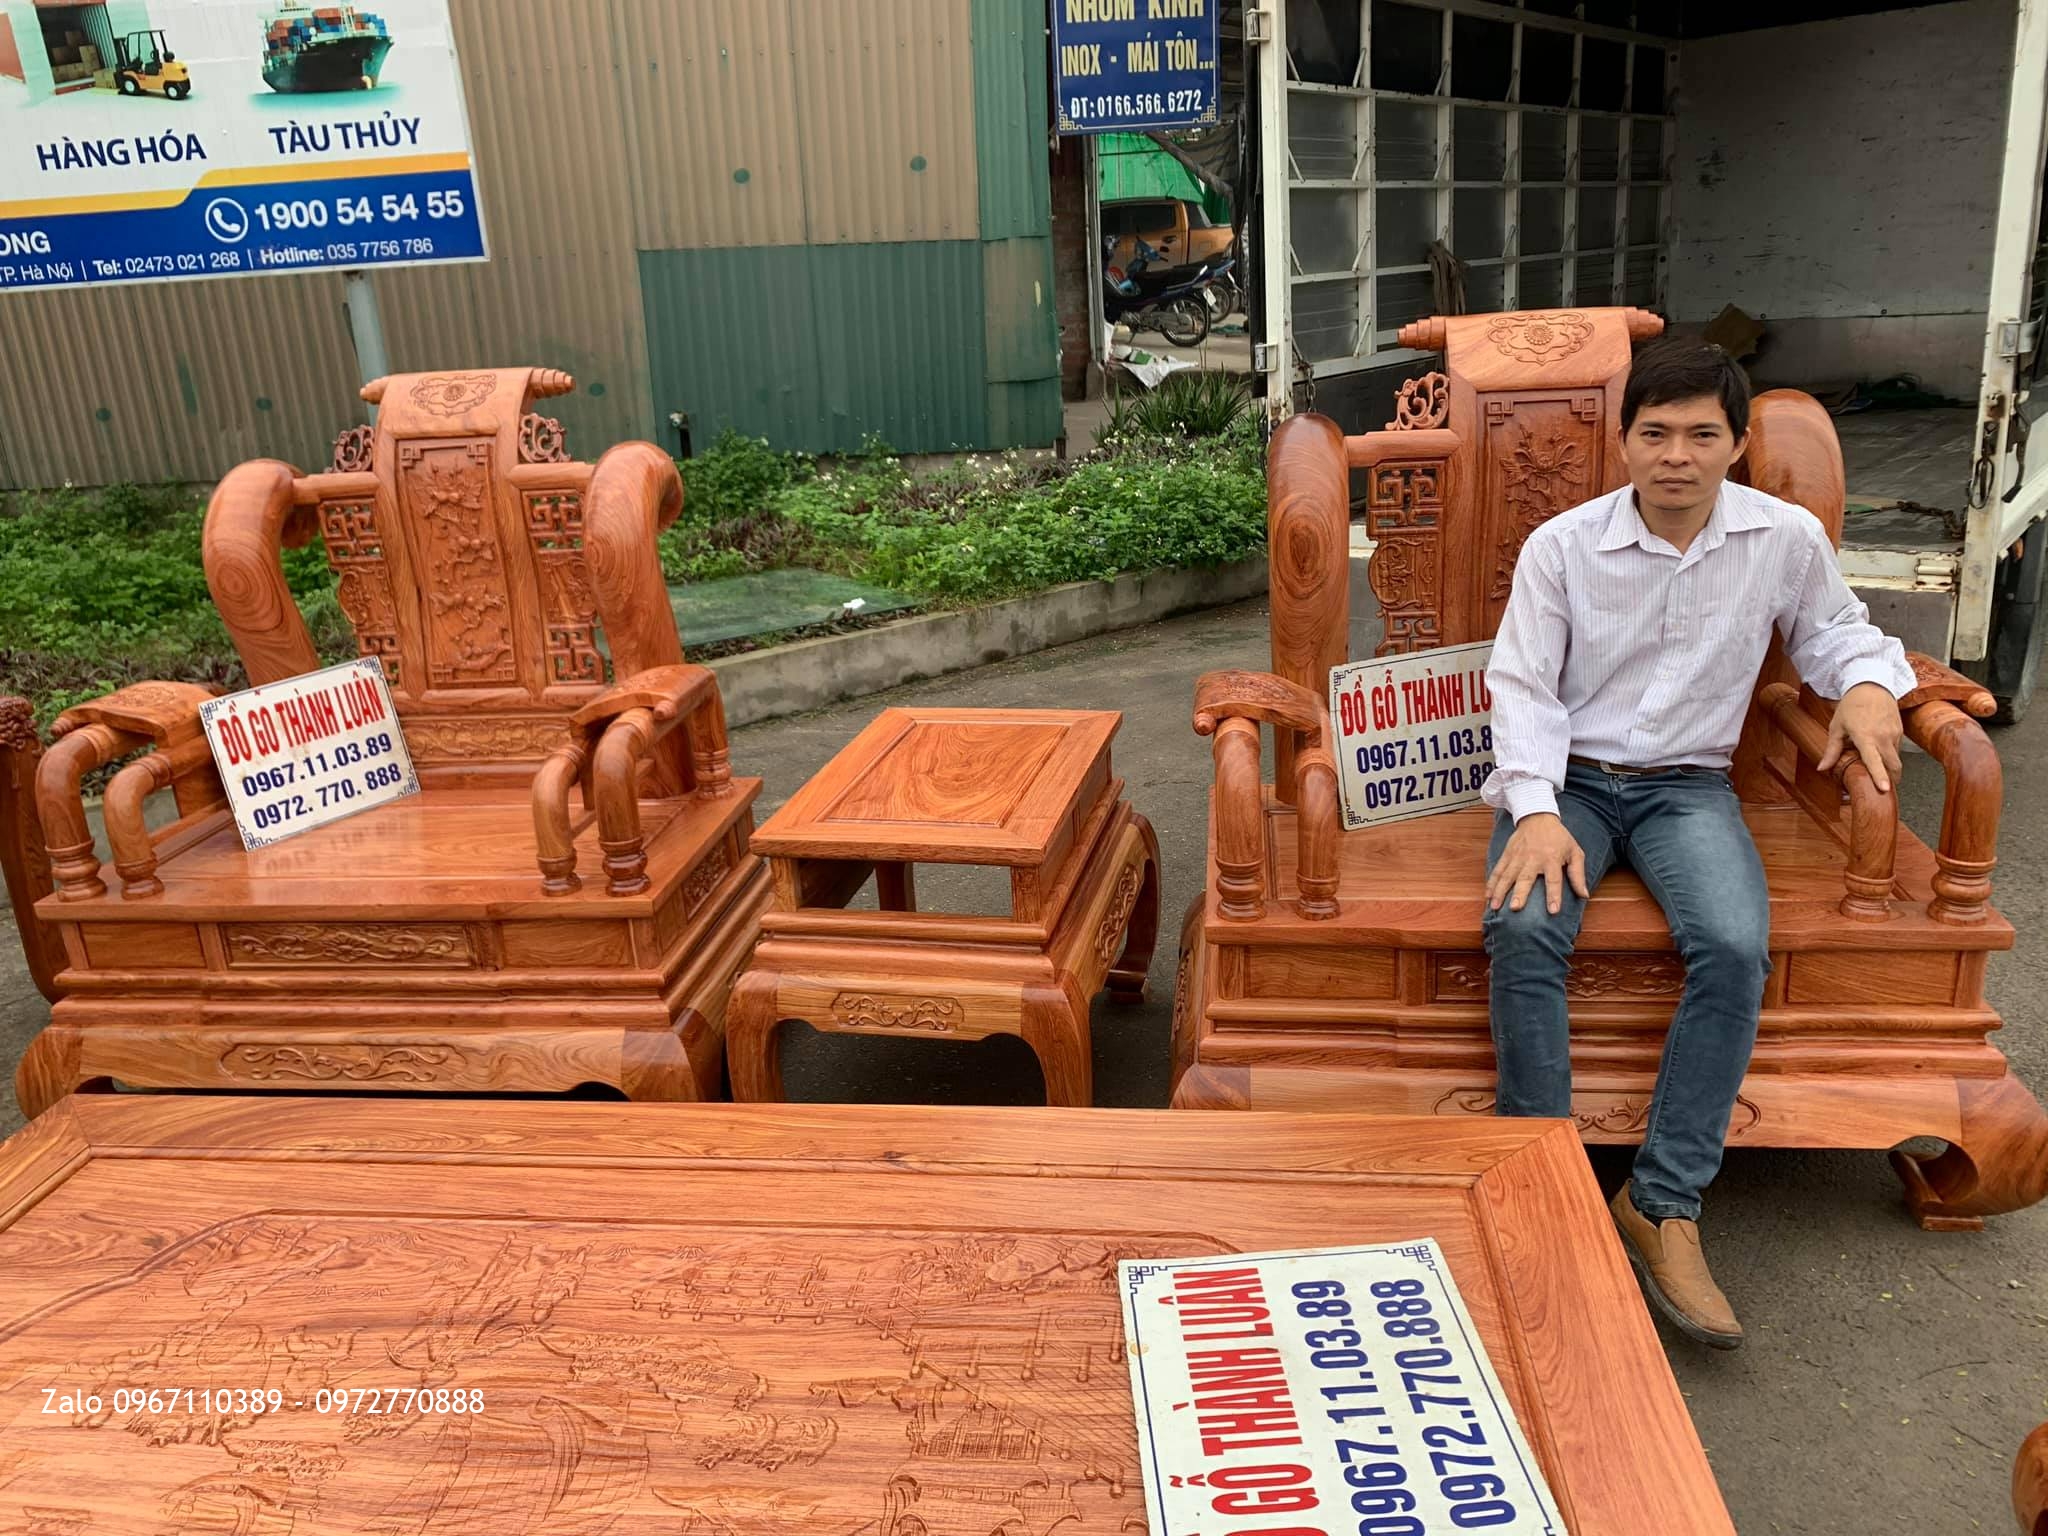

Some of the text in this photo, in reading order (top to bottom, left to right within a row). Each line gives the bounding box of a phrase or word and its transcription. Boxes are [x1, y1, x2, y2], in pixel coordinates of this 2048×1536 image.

[1062, 44, 1102, 76] INOX
[1127, 32, 1159, 73] MÁI
[36, 129, 207, 171] HÀNG HÓA
[268, 110, 420, 154] TÀU THỦY
[254, 190, 464, 231] 1900 54 54 55
[20, 264, 45, 281] Hà
[46, 261, 74, 281] Nội
[92, 251, 240, 276] Tel: 02473 021 268
[259, 237, 433, 265] Hotline: 035 7756 786
[274, 688, 341, 748] THÀNH
[334, 670, 386, 731] LUÂN
[1340, 668, 1492, 737] ĐỒ GỖ THÀNH LU
[242, 733, 392, 797] 0967.11.03.89
[1356, 725, 1493, 774] 0967.11.03.8
[1365, 761, 1496, 809] 0972.770.88
[1158, 1267, 1274, 1341] LUÂN
[1172, 1347, 1303, 1457] THÀNH
[1370, 1278, 1517, 1528] 0972.770.888
[1169, 1463, 1320, 1516] GỖ
